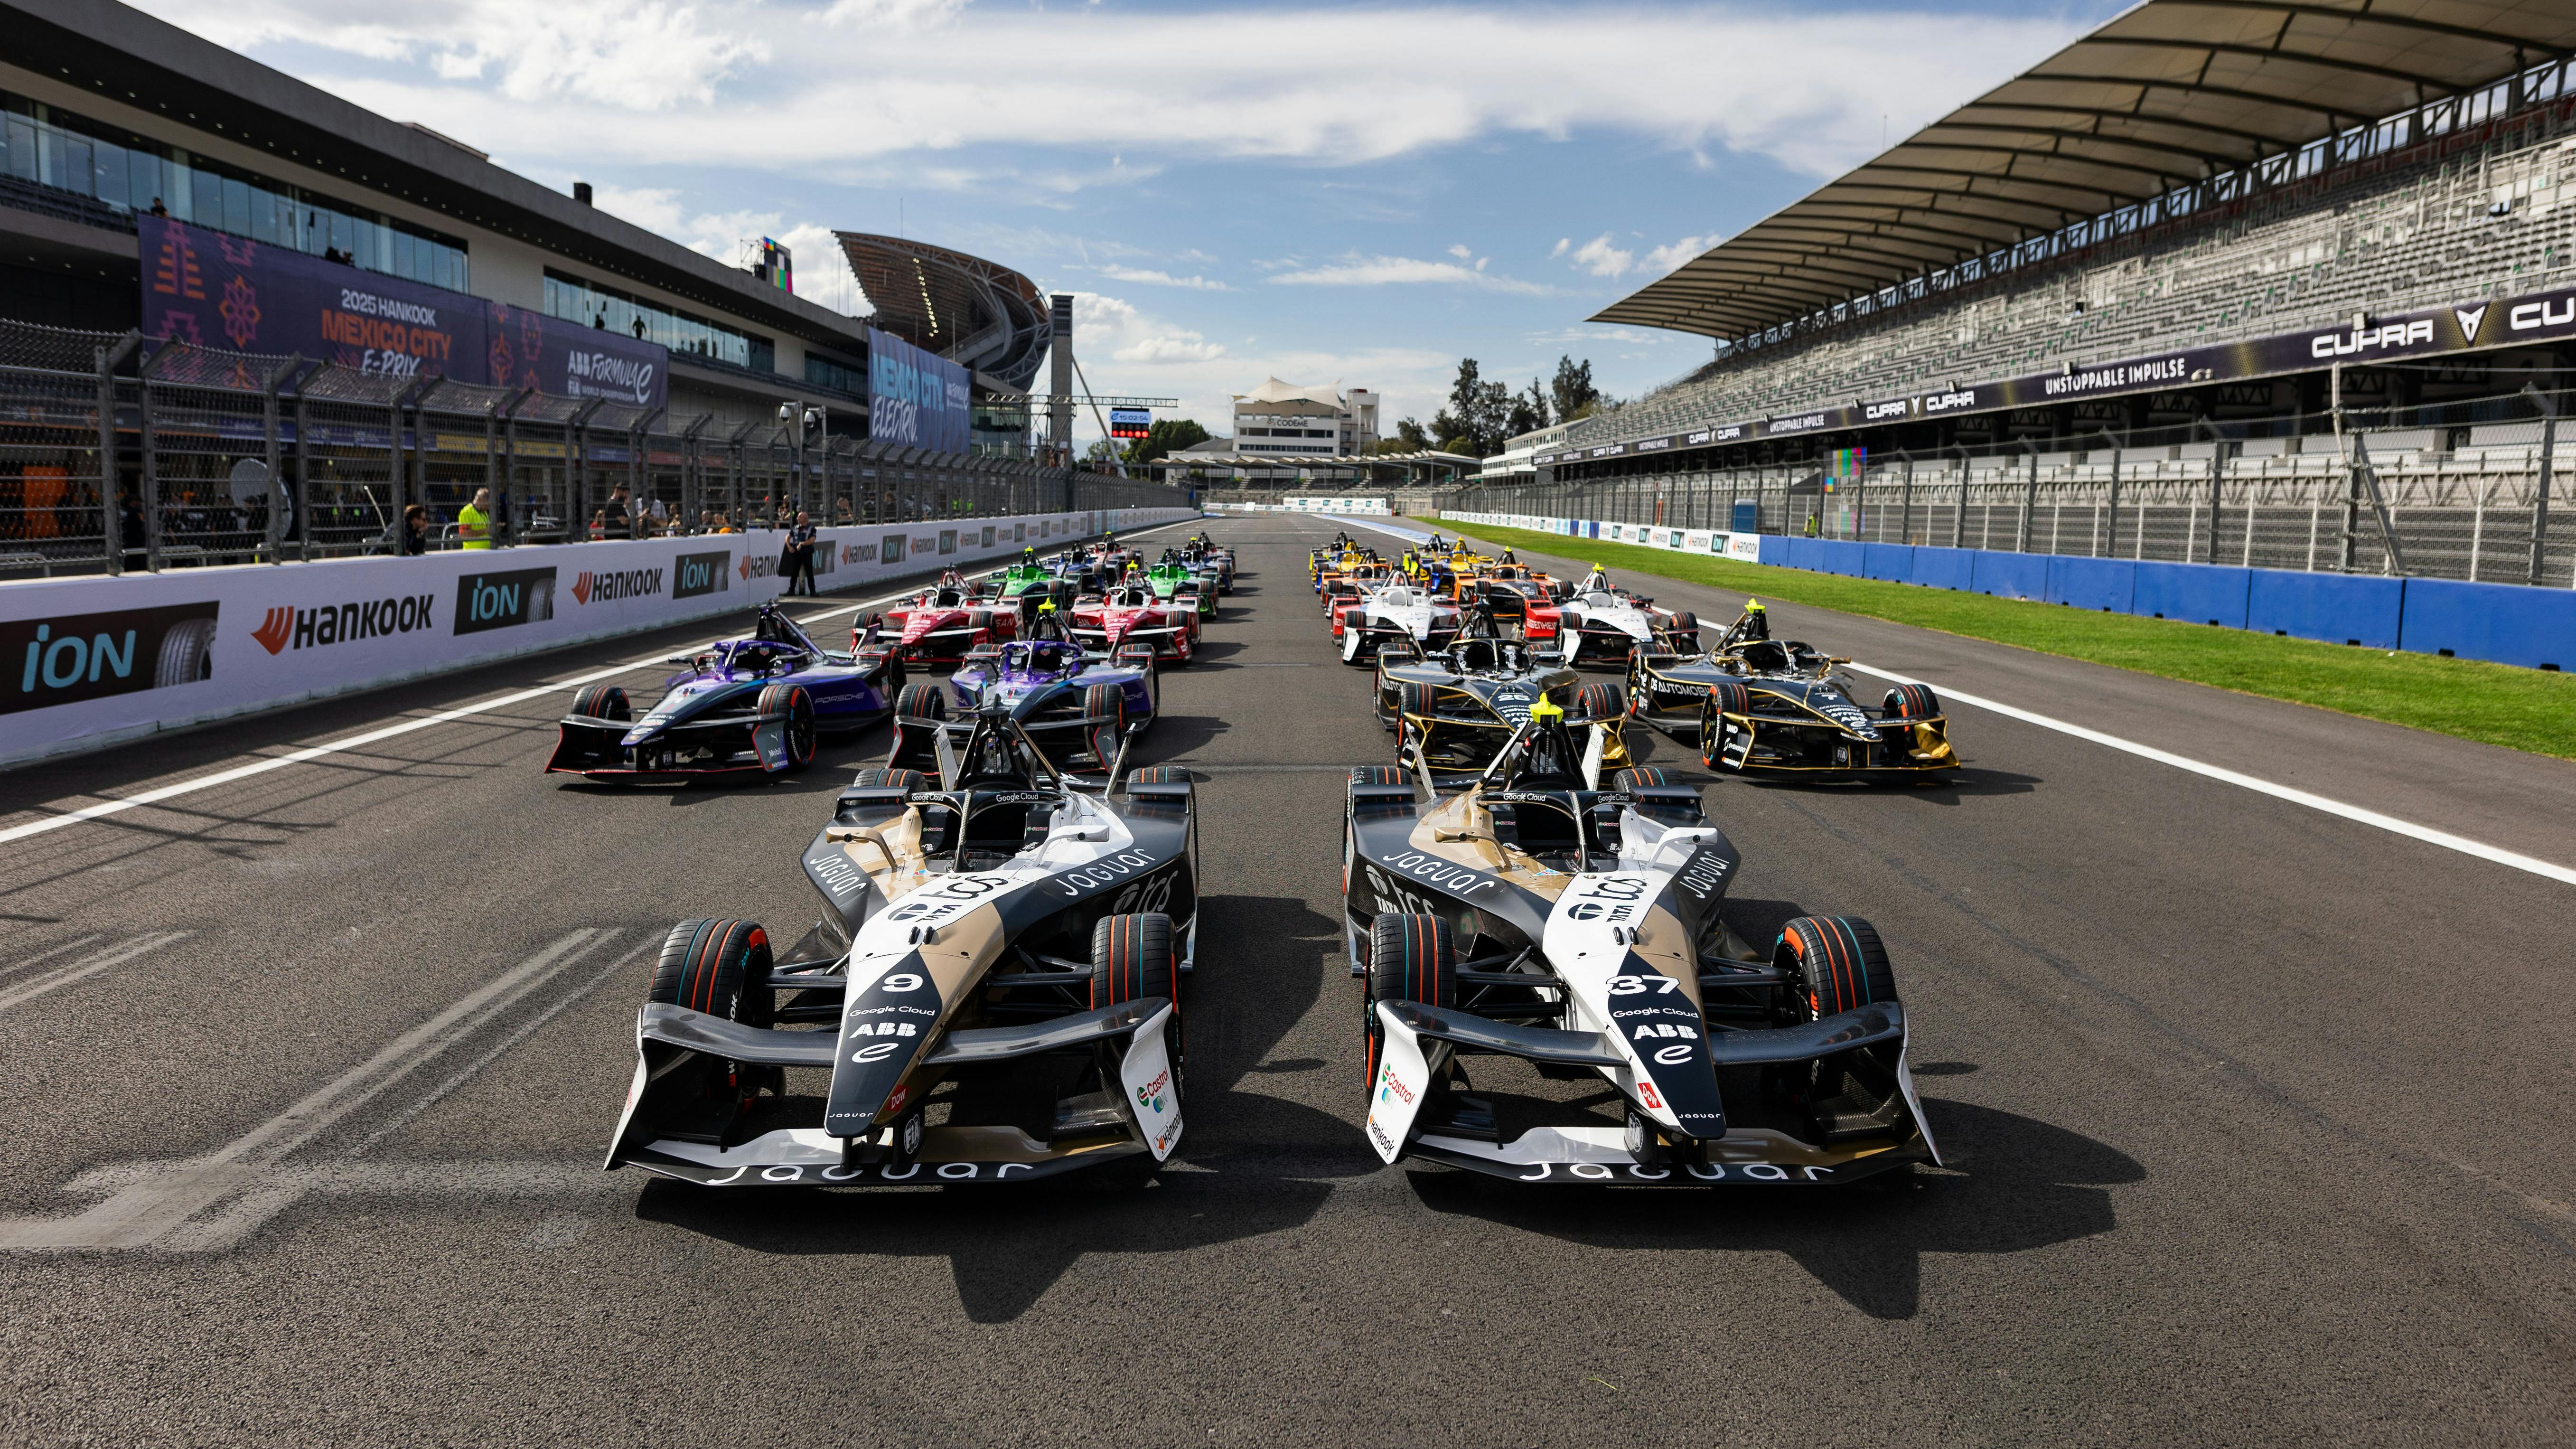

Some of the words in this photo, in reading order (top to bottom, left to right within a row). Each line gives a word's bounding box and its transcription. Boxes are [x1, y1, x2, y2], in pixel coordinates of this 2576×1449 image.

[341, 288, 377, 315] 2025
[378, 297, 436, 327] HANKOOK
[321, 309, 407, 353] MEXICO
[409, 328, 451, 361] CITY
[2312, 320, 2433, 358] CUPRA
[362, 348, 421, 381] E-PRIX
[568, 350, 590, 376] ABB
[590, 353, 639, 388] FORMULA
[872, 352, 920, 405] MEXICO
[2045, 367, 2125, 395] UNSTOPPABLE
[2129, 358, 2185, 384] IMPULSE
[582, 386, 600, 396] WORLD
[1866, 401, 1905, 419] CUPRA
[1927, 391, 1974, 411] CUPRA
[1770, 417, 1802, 433] UNSTOPPABLE
[1803, 414, 1824, 427] IMPULSE
[1689, 432, 1709, 444] CUPRA
[1717, 427, 1740, 440] CUPRA
[1651, 677, 1658, 691] DS
[815, 692, 865, 704] PORSCHE
[768, 748, 780, 757] Mobil
[912, 794, 929, 802] Google
[929, 793, 944, 801] Cloud
[996, 794, 1020, 802] Google
[1503, 792, 1525, 801] Google
[1527, 793, 1546, 801] Cloud
[1598, 794, 1615, 803] Google
[1615, 793, 1629, 801] Cloud
[916, 904, 963, 922] TATA
[1606, 905, 1634, 922] TATA
[882, 974, 923, 992] 9
[1606, 975, 1680, 995] 37
[850, 1006, 895, 1017] Google
[899, 1006, 935, 1016] Cloud
[1613, 1007, 1660, 1017] Google
[1663, 1008, 1698, 1018] Cloud
[849, 1022, 917, 1039] ABB
[1634, 1024, 1698, 1040] ABB
[1147, 1066, 1169, 1097] Castrol
[1388, 1072, 1415, 1105] Castrol
